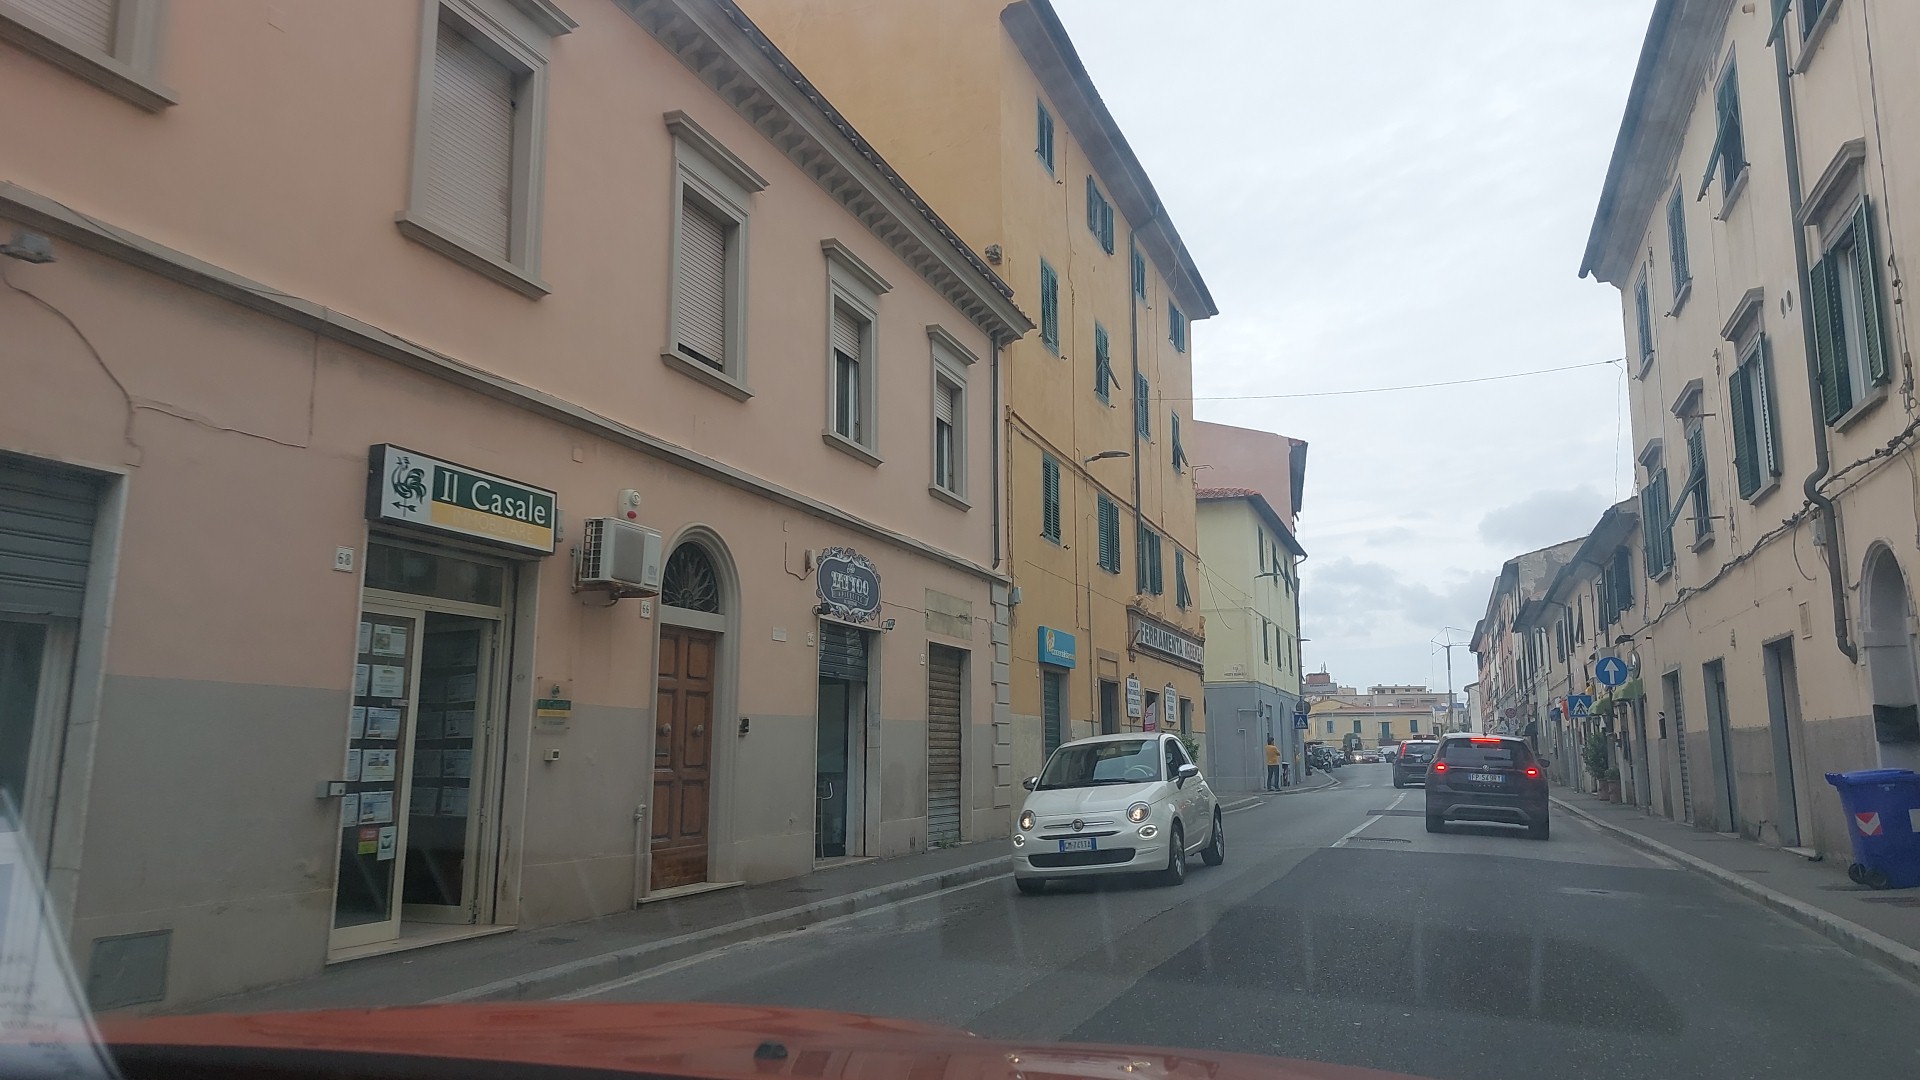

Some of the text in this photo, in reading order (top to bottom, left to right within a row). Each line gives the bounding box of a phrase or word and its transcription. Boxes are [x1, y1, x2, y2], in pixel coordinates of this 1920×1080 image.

[440, 470, 546, 525] Il Casale
[452, 508, 536, 542] IMMOBILIARE
[337, 552, 351, 566] 68
[830, 570, 870, 596] TATTOO
[1140, 622, 1184, 657] FERRAMENTA
